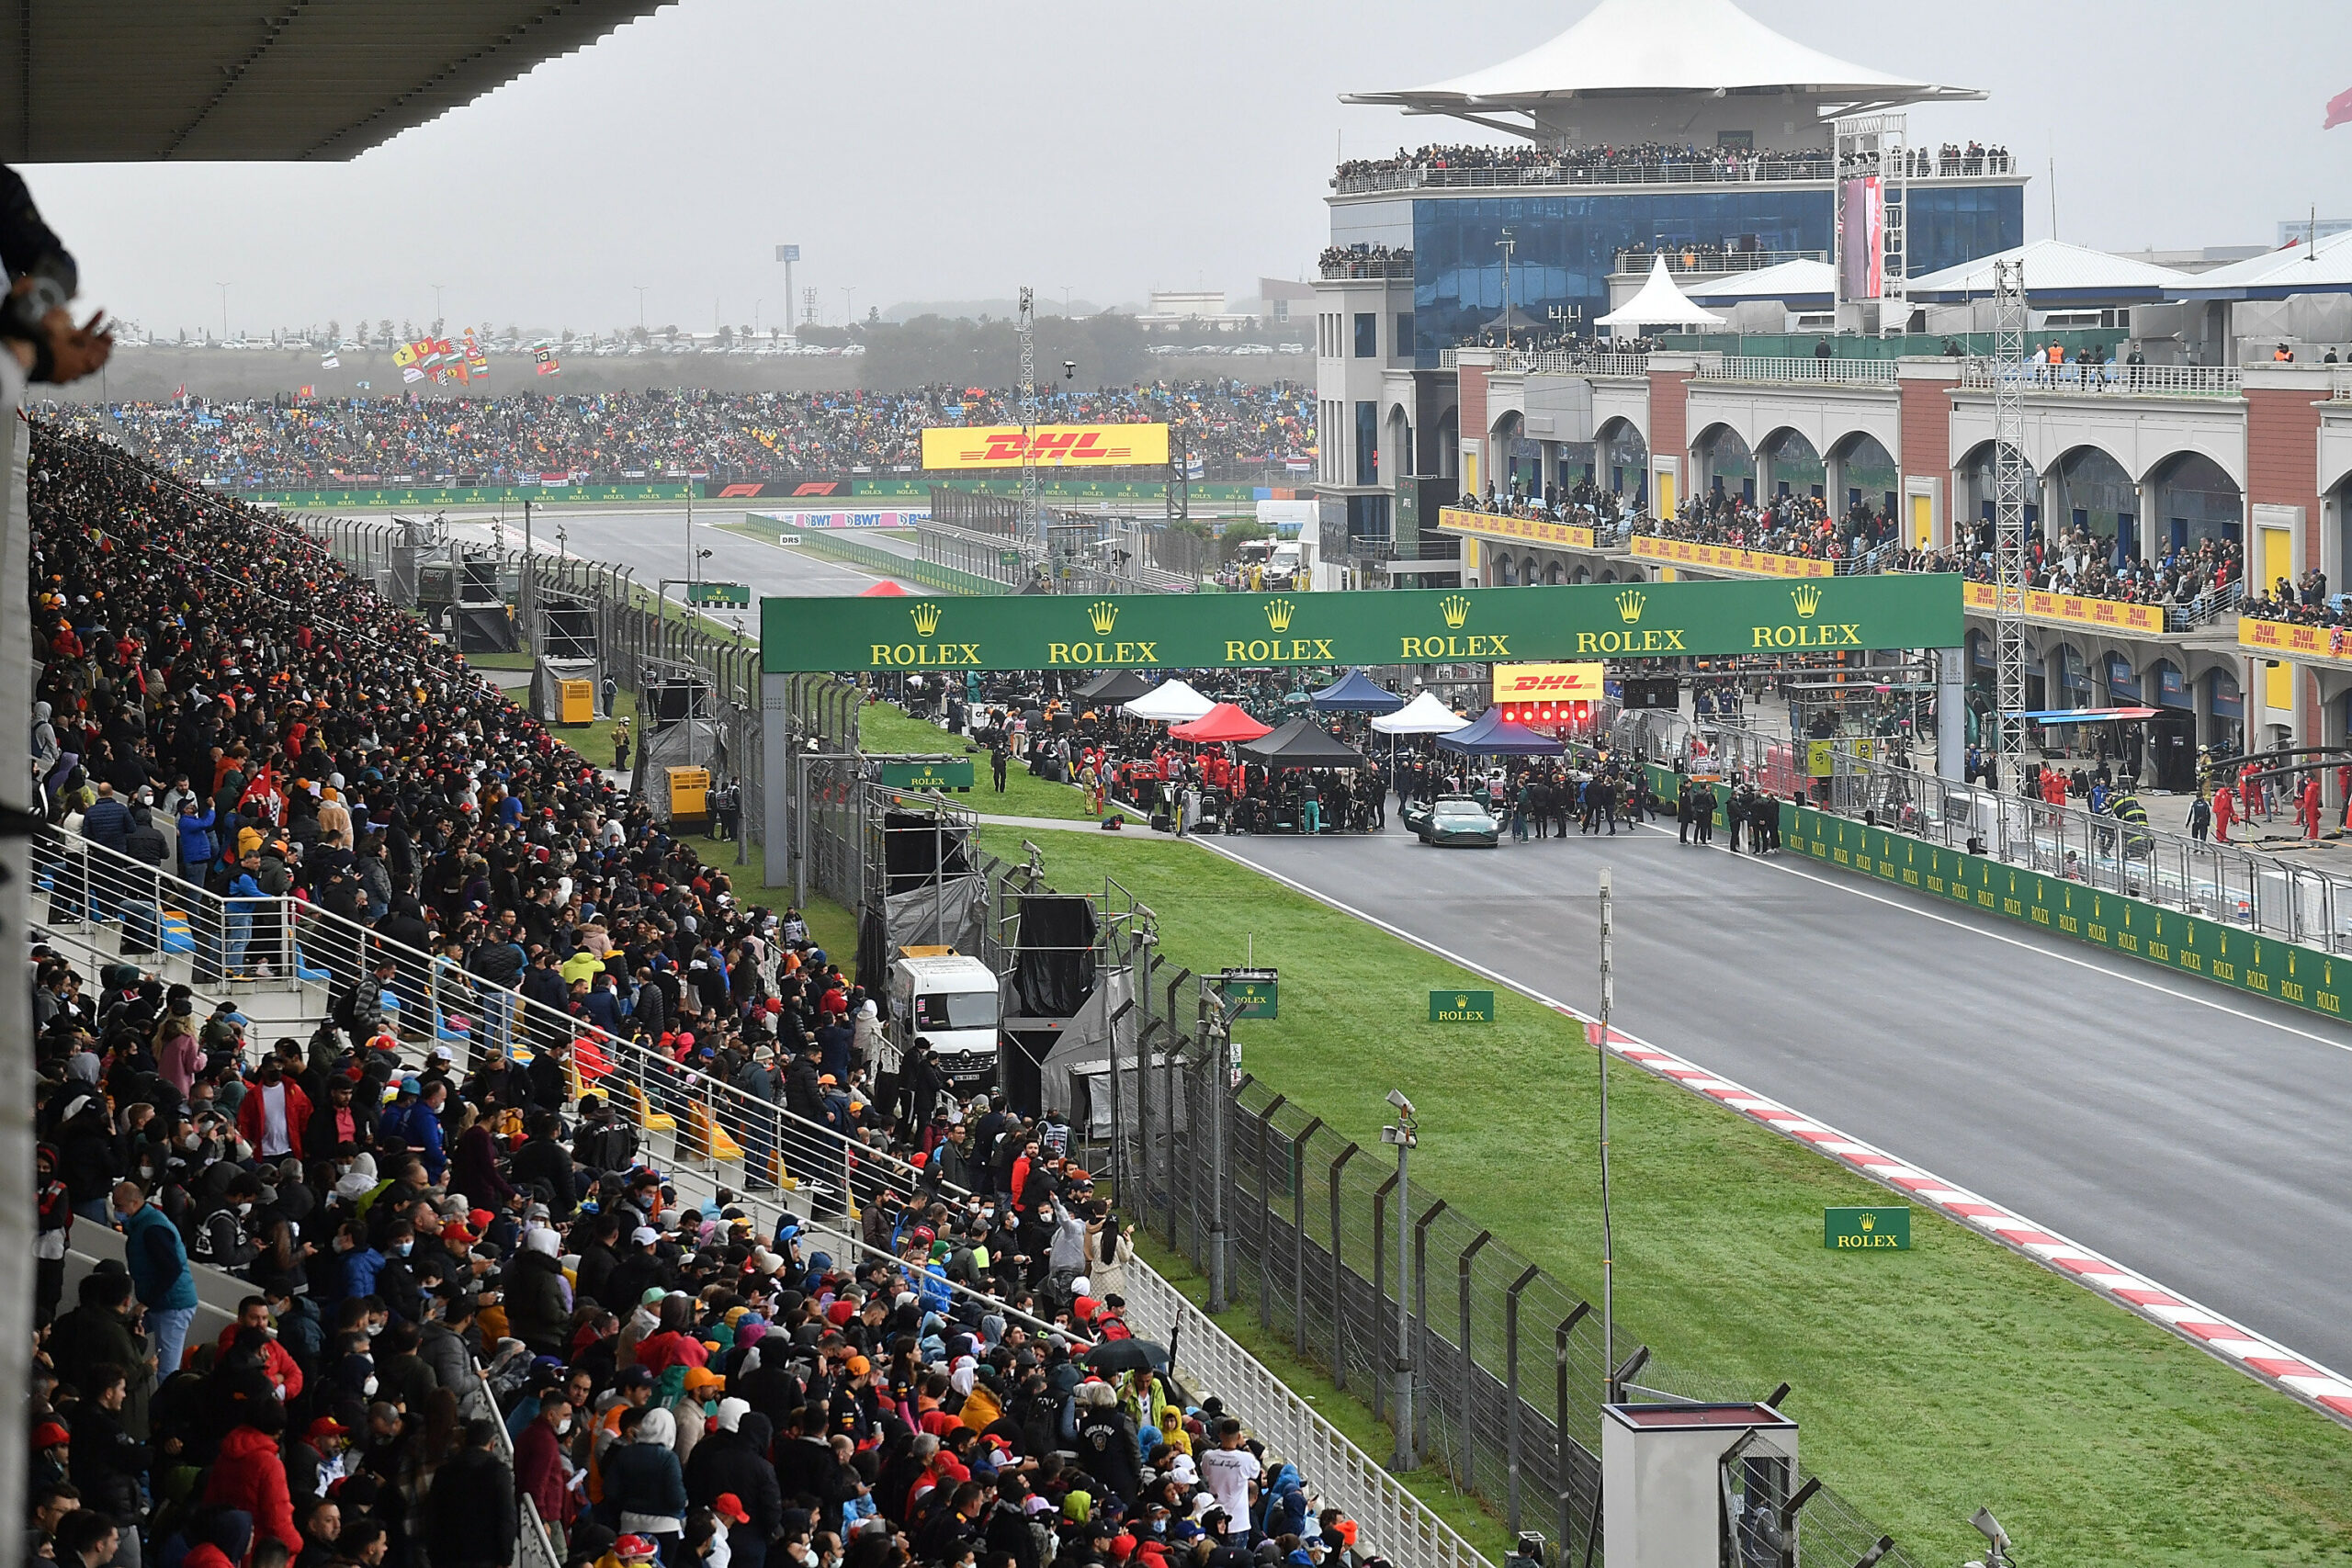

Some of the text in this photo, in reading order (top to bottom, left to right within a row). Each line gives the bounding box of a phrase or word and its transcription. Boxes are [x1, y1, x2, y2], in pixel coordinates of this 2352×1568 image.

[983, 433, 1108, 459] DHL
[810, 514, 831, 526] BWT
[854, 513, 881, 526] BWT
[1977, 587, 1994, 604] DHL
[2034, 594, 2052, 614] DHL
[2064, 599, 2083, 618] DHL
[2096, 604, 2114, 622] DHL
[2129, 607, 2147, 626] DHL
[1577, 630, 1687, 653] ROLEX
[1752, 624, 1862, 648] ROLEX
[2256, 624, 2277, 645] DHL
[2292, 628, 2315, 649] DHL
[871, 644, 982, 666] ROLEX
[1048, 642, 1159, 664] ROLEX
[1225, 639, 1336, 661] ROLEX
[1400, 635, 1510, 658] ROLEX
[1513, 675, 1584, 691] DHL
[1857, 853, 1871, 871] ROLEX
[1880, 861, 1894, 878] ROLEX
[1903, 868, 1918, 885] ROLEX
[1928, 874, 1943, 892] ROLEX
[1951, 882, 1968, 900] ROLEX
[1978, 889, 1994, 908] ROLEX
[2004, 897, 2021, 916] ROLEX
[2031, 906, 2049, 924] ROLEX
[2059, 914, 2077, 933] ROLEX
[2088, 922, 2107, 942] ROLEX
[2118, 931, 2137, 952] ROLEX
[2149, 941, 2168, 961] ROLEX
[2181, 950, 2200, 970] ROLEX
[2212, 959, 2234, 980] ROLEX
[2247, 970, 2268, 991] ROLEX
[2280, 979, 2303, 1001] ROLEX
[1235, 996, 1266, 1004] ROLEX
[2317, 990, 2339, 1012] ROLEX
[1438, 1010, 1484, 1021] ROLEX
[1838, 1235, 1898, 1247] ROLEX
